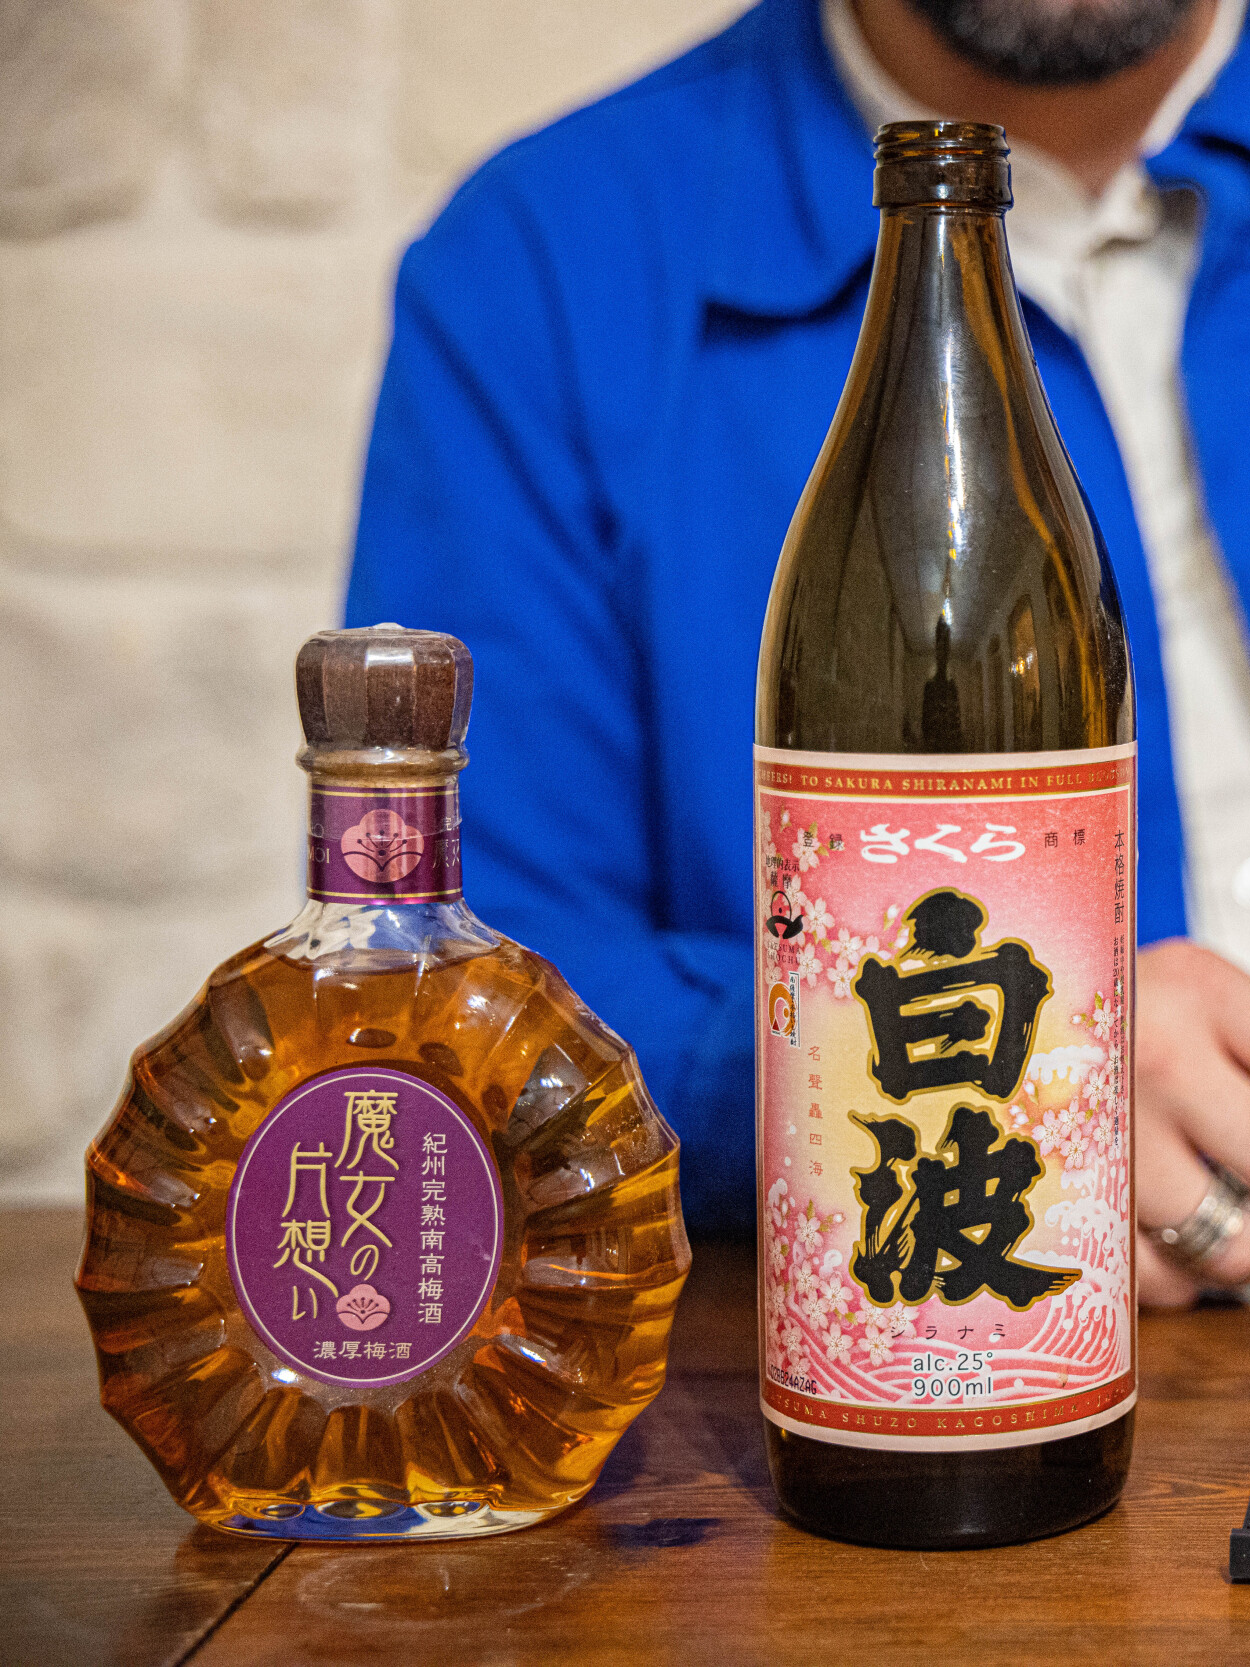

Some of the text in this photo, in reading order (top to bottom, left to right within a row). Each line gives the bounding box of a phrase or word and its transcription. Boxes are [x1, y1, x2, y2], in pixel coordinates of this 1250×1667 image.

[759, 768, 793, 785] HEERS!
[801, 774, 819, 787] TO
[825, 776, 893, 790] SAKURA
[902, 775, 1012, 791] SHIRANAMI
[1020, 774, 1038, 788] IN
[1046, 773, 1082, 787] FULL
[860, 823, 1026, 864] さくら
[1044, 828, 1086, 849] 商標
[1114, 829, 1125, 925] 本格焼酎
[849, 887, 1083, 1312] 白波
[335, 1089, 400, 1281] 魔女の
[273, 1141, 339, 1321] 片想い
[418, 1132, 448, 1324] 紀州完熟南高梅酒
[889, 1323, 1007, 1340] シラナミ
[313, 1341, 413, 1360] 濃厚梅酒
[912, 1351, 994, 1373] alc.25°
[912, 1377, 993, 1397] 900ml
[771, 1394, 1079, 1429] SUMA SHUZO KAGOSHIMA
